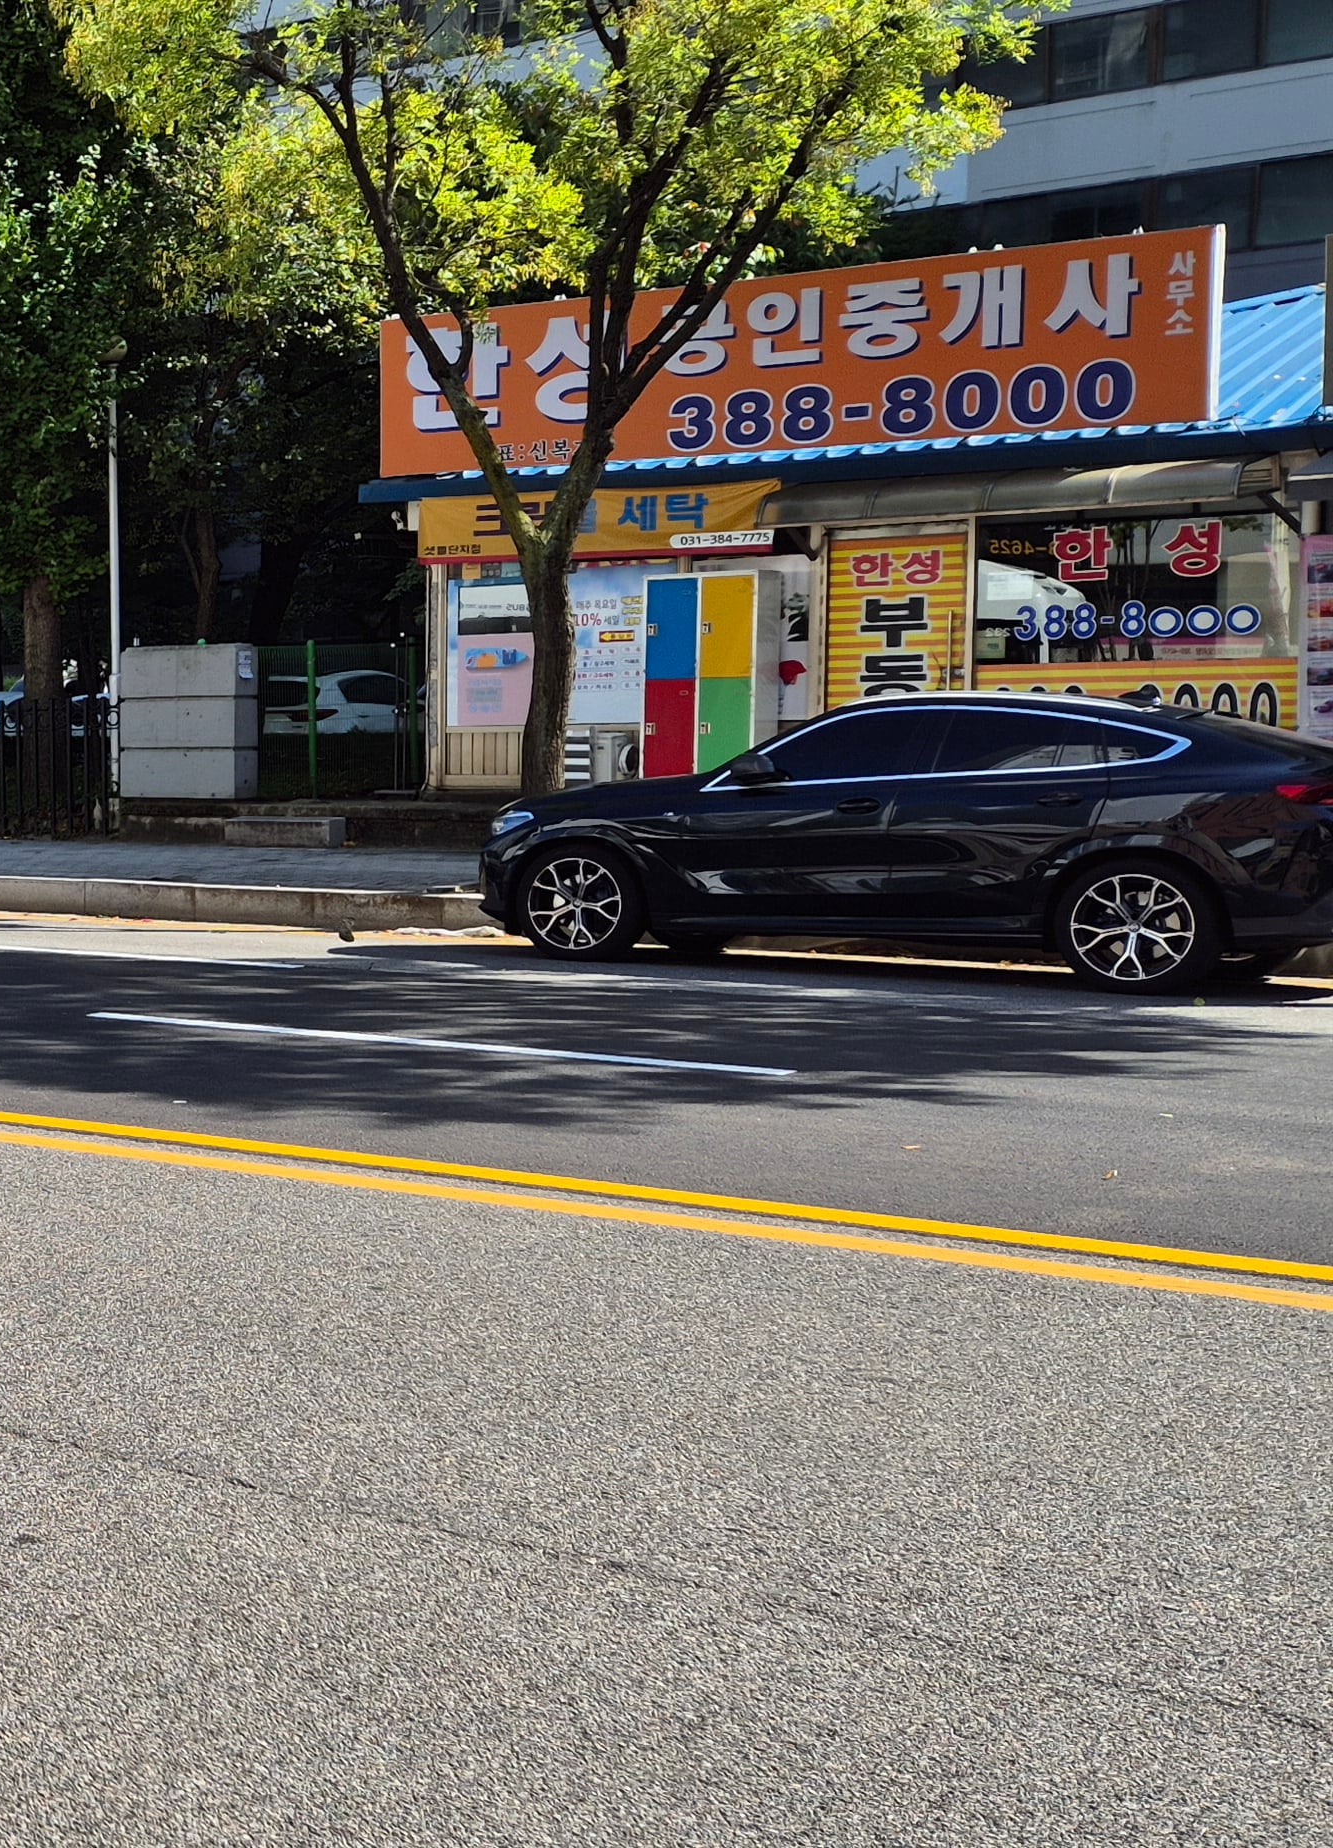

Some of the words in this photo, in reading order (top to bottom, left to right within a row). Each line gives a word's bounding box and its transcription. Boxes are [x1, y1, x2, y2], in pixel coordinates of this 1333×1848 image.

[1165, 250, 1196, 336] 사무소
[659, 253, 1141, 377] 공인중개사
[667, 357, 1137, 452] 388-8000
[618, 493, 709, 531] 세탁
[680, 532, 770, 547] 031-384-7775
[850, 549, 943, 588] 한성
[573, 612, 602, 626] 10%
[1014, 600, 1262, 642] 388-8000
